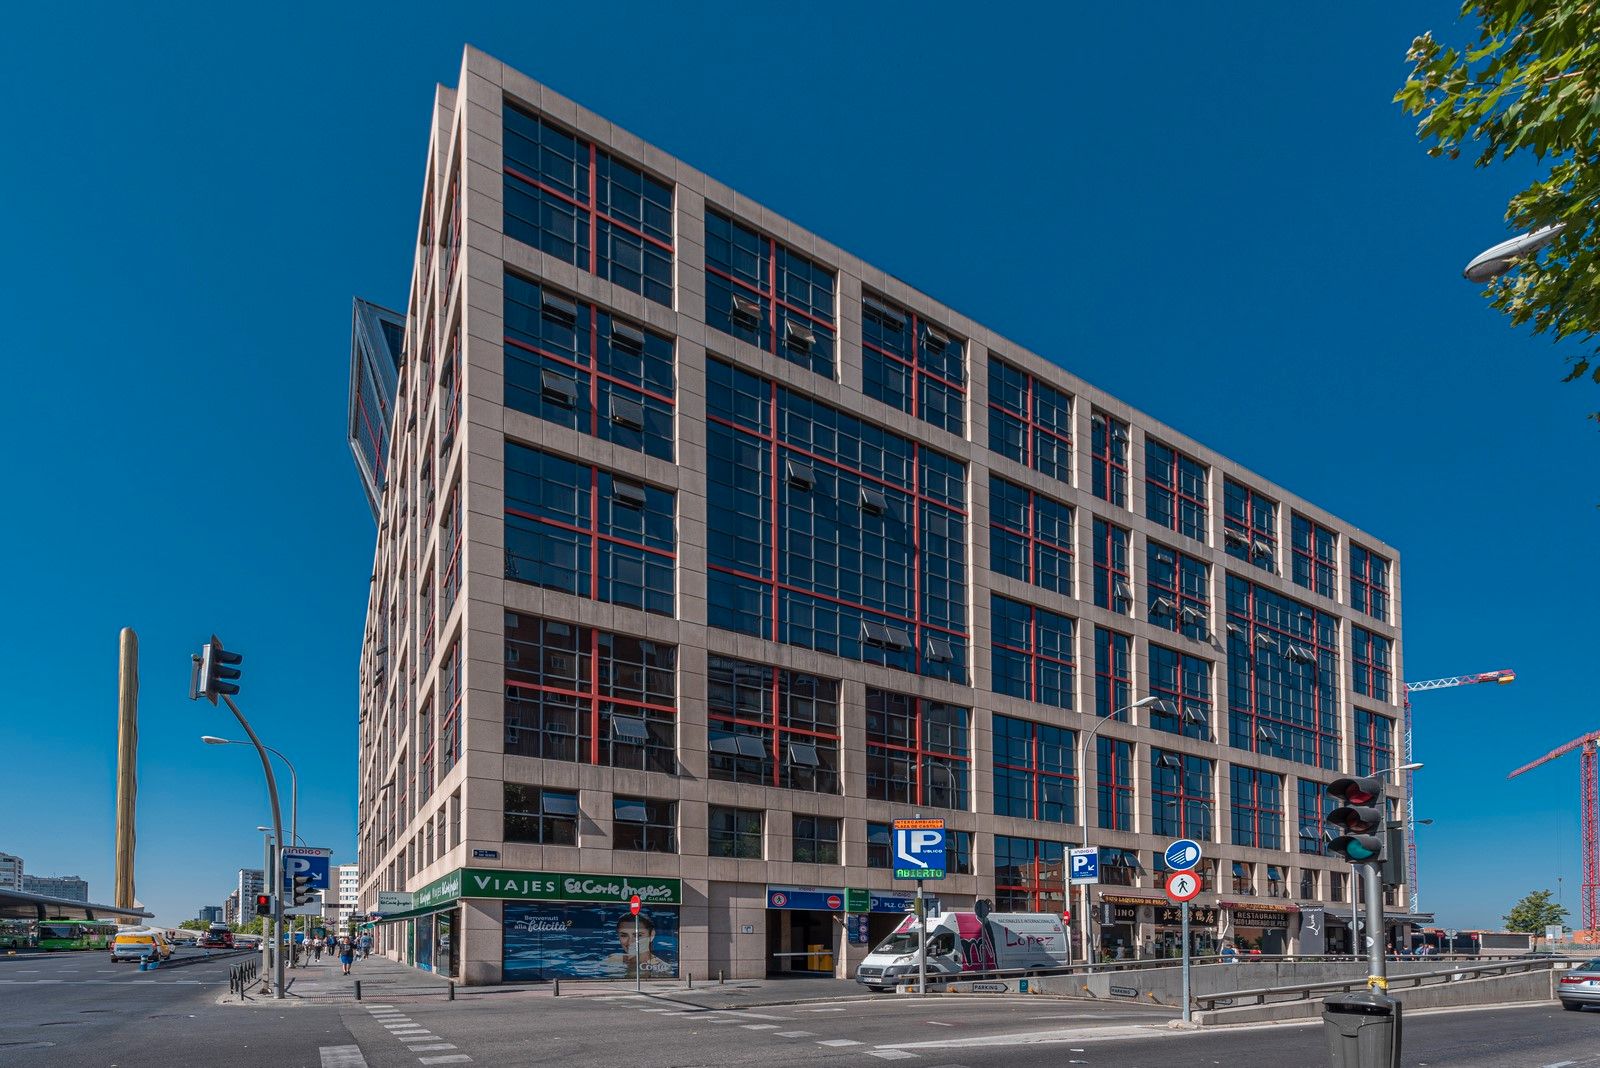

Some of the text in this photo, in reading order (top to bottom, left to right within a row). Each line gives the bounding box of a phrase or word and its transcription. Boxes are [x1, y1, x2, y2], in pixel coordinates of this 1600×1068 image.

[286, 857, 310, 878] P
[1073, 856, 1088, 871] P
[897, 869, 942, 878] ABIERTO
[474, 875, 555, 894] VIAJES
[564, 878, 672, 901] El Corte Inglés
[1237, 912, 1285, 920] RESTAURANTE
[1005, 927, 1055, 952] López
